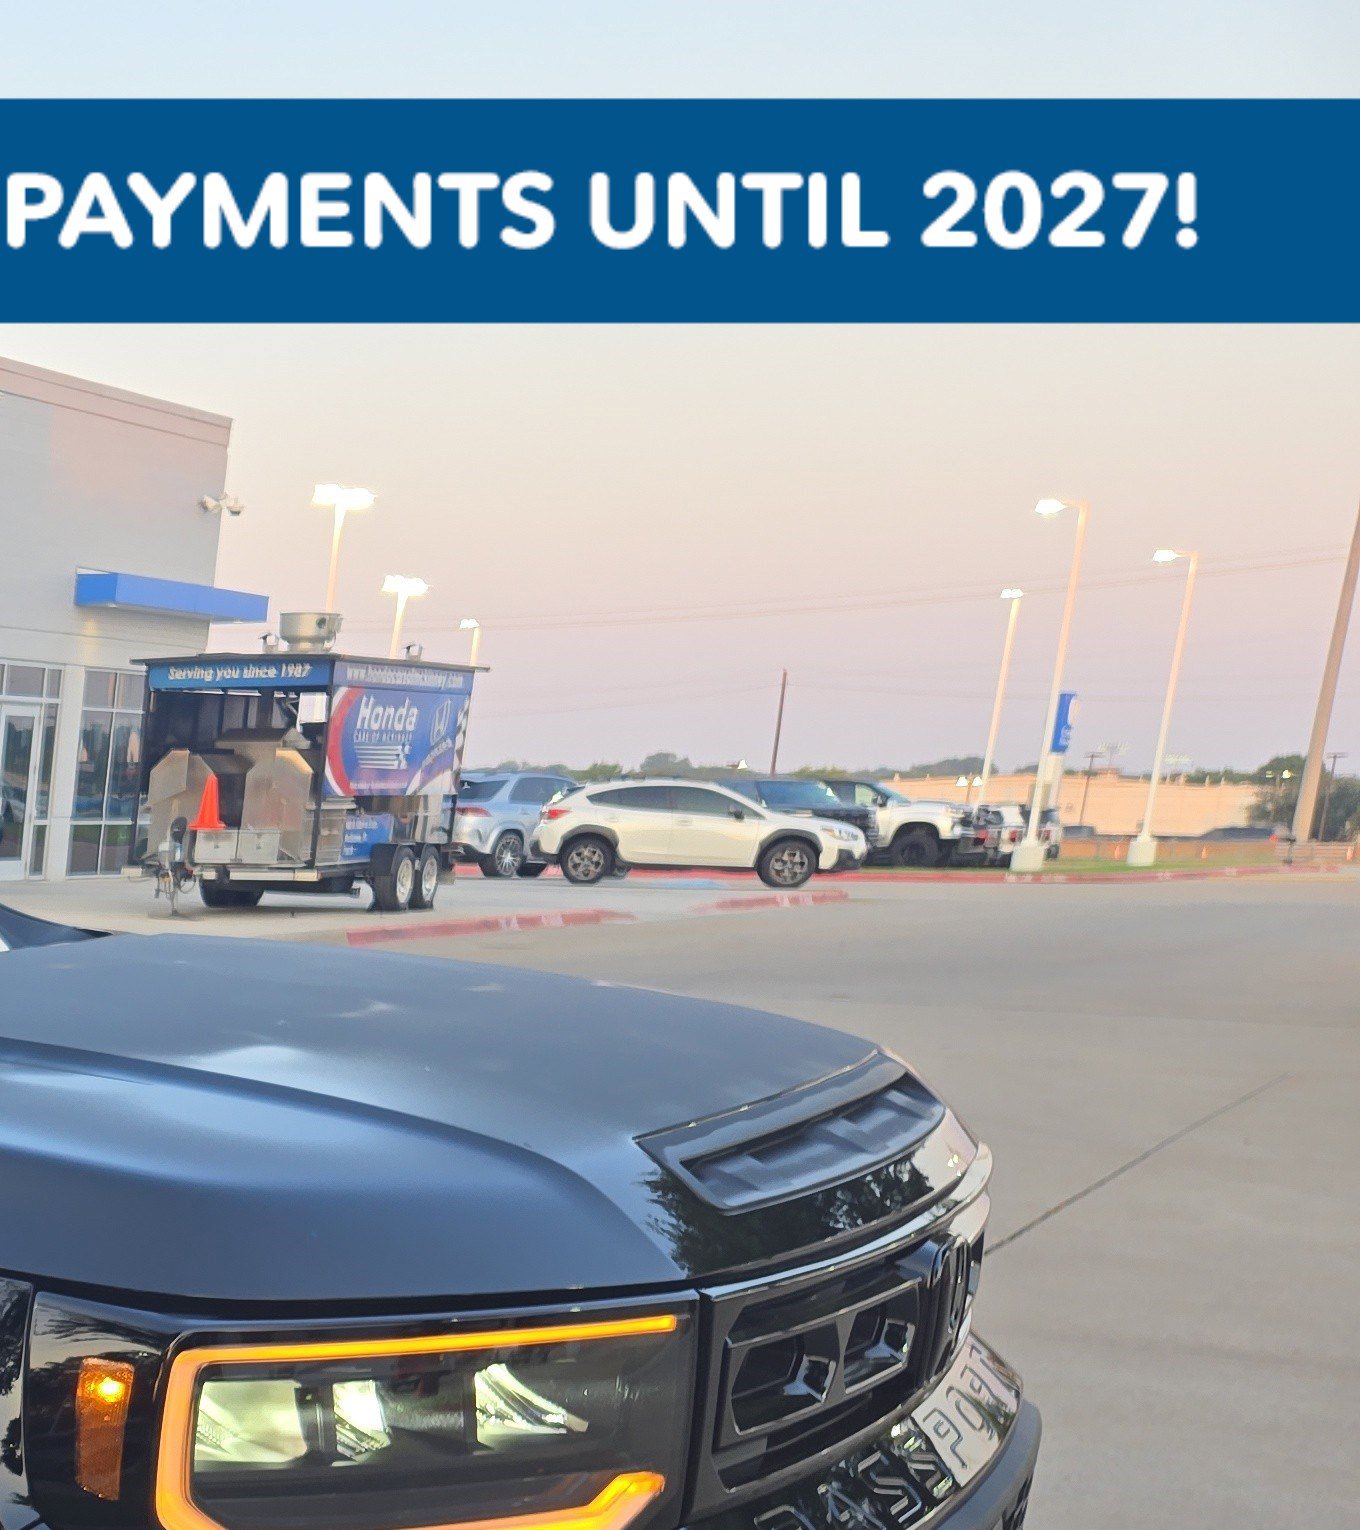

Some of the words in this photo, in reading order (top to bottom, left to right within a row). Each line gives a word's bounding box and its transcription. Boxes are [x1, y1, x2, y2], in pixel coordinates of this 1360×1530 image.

[168, 665, 214, 682] Serving
[215, 665, 240, 682] you
[242, 664, 277, 679] since
[281, 662, 312, 678] 1987
[356, 695, 418, 731] Honda
